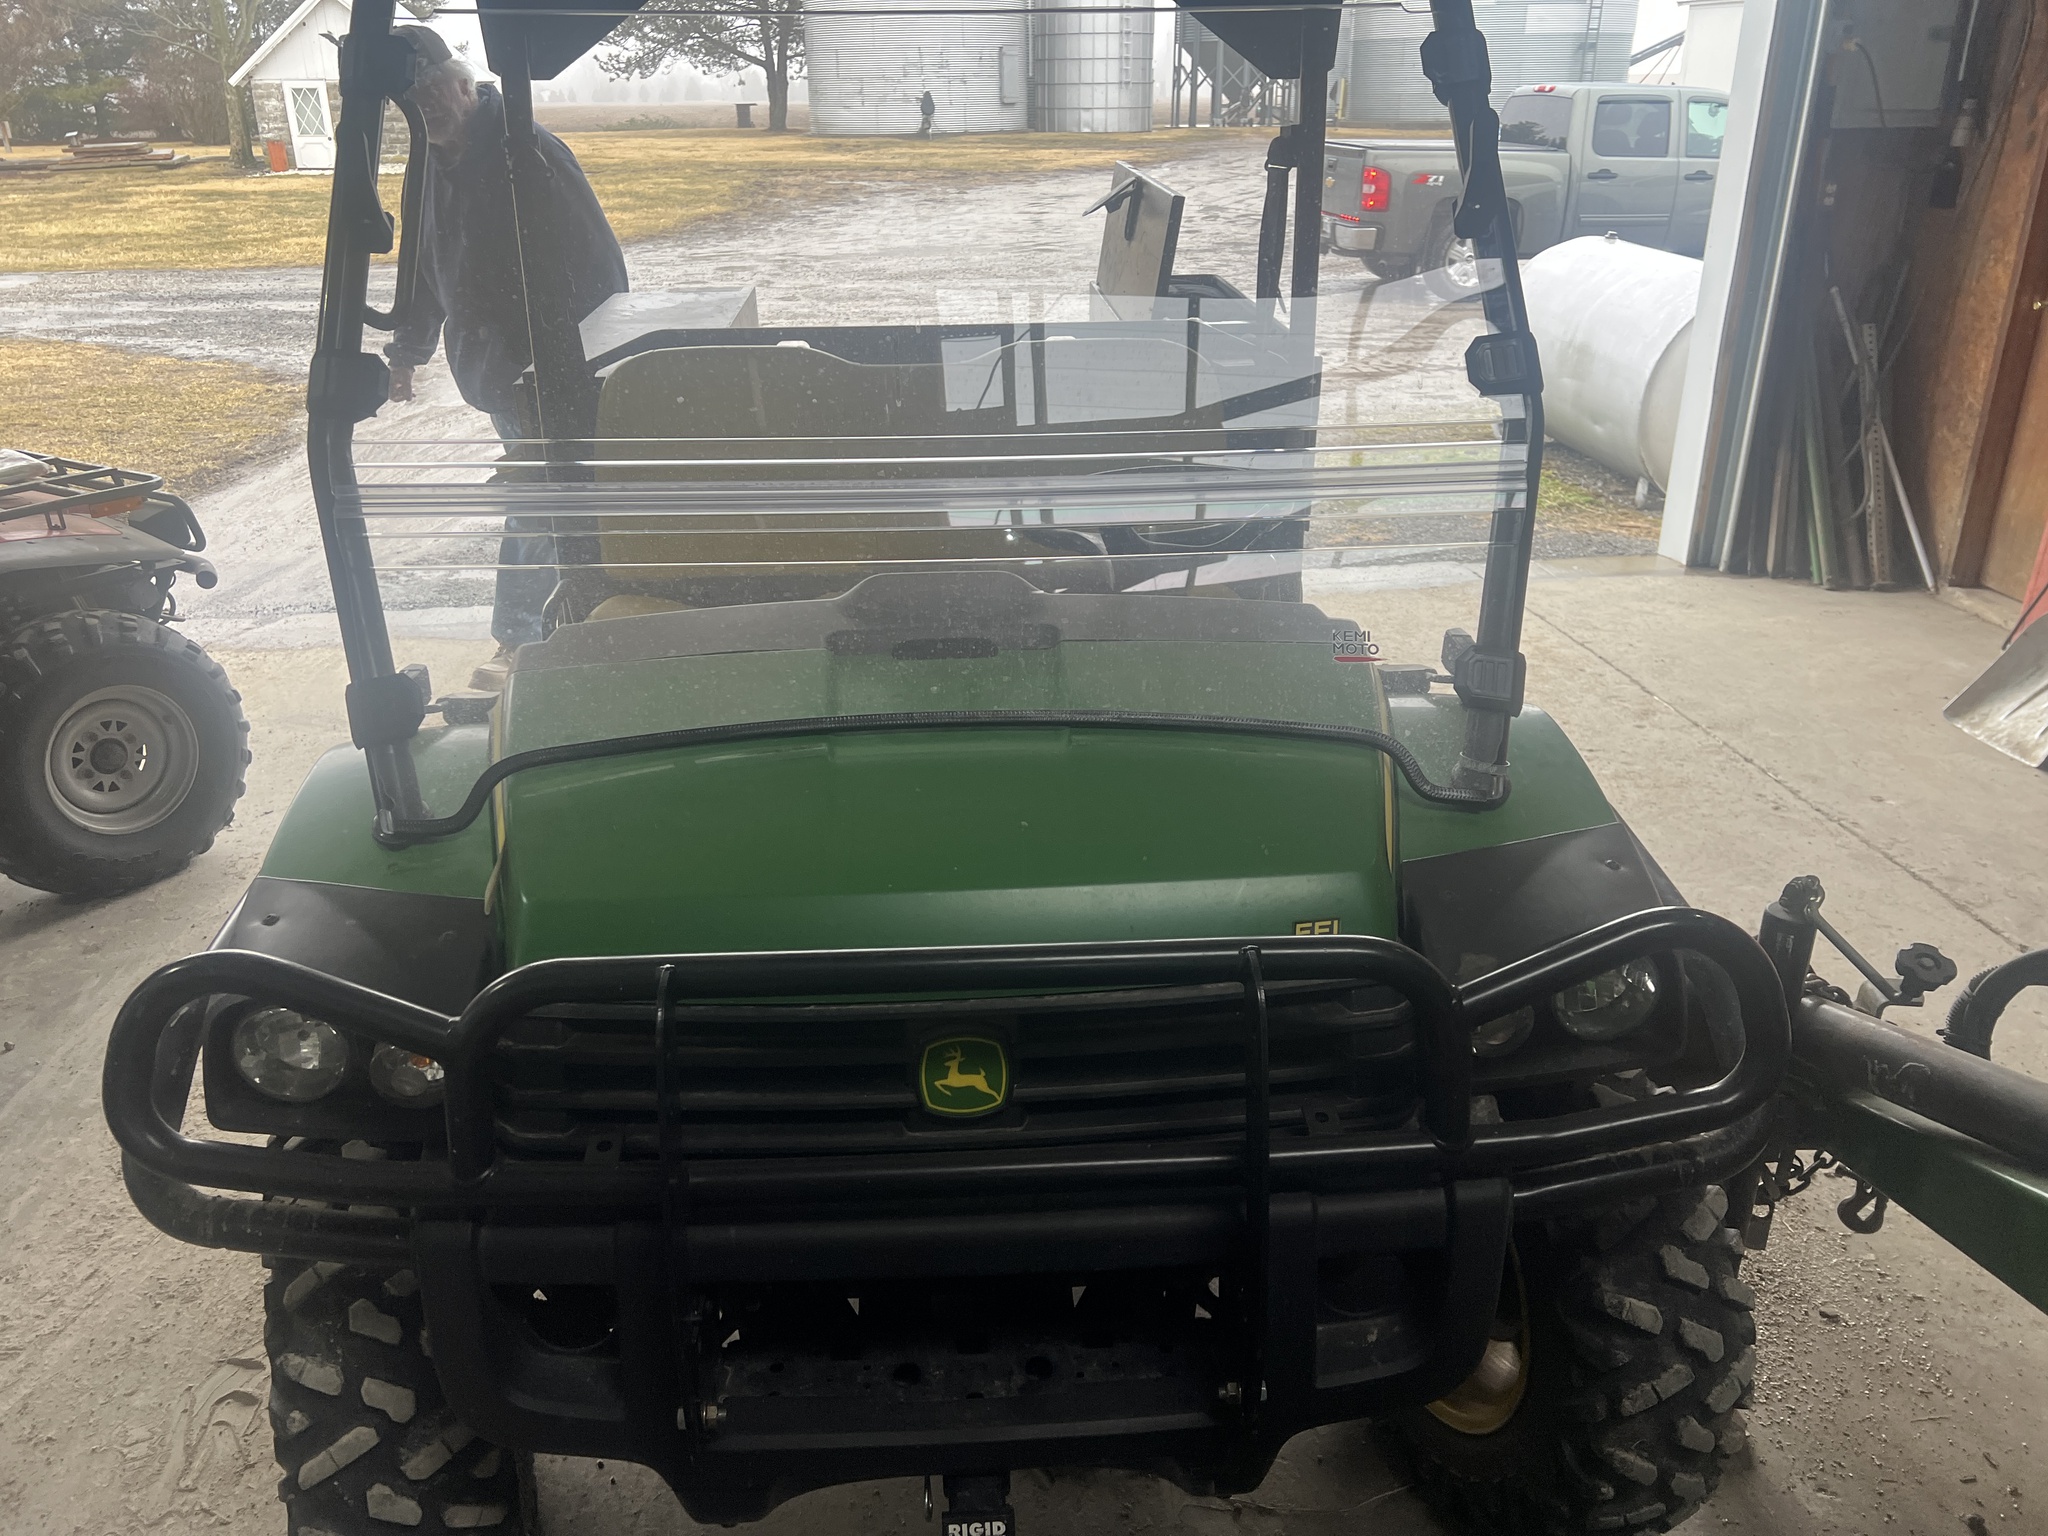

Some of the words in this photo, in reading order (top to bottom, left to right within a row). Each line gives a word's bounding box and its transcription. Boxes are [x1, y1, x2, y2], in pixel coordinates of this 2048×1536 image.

[1411, 173, 1445, 184] Z71
[1332, 630, 1371, 642] KEMI
[1332, 643, 1380, 655] MOTO
[948, 1521, 1007, 1536] RIGID
